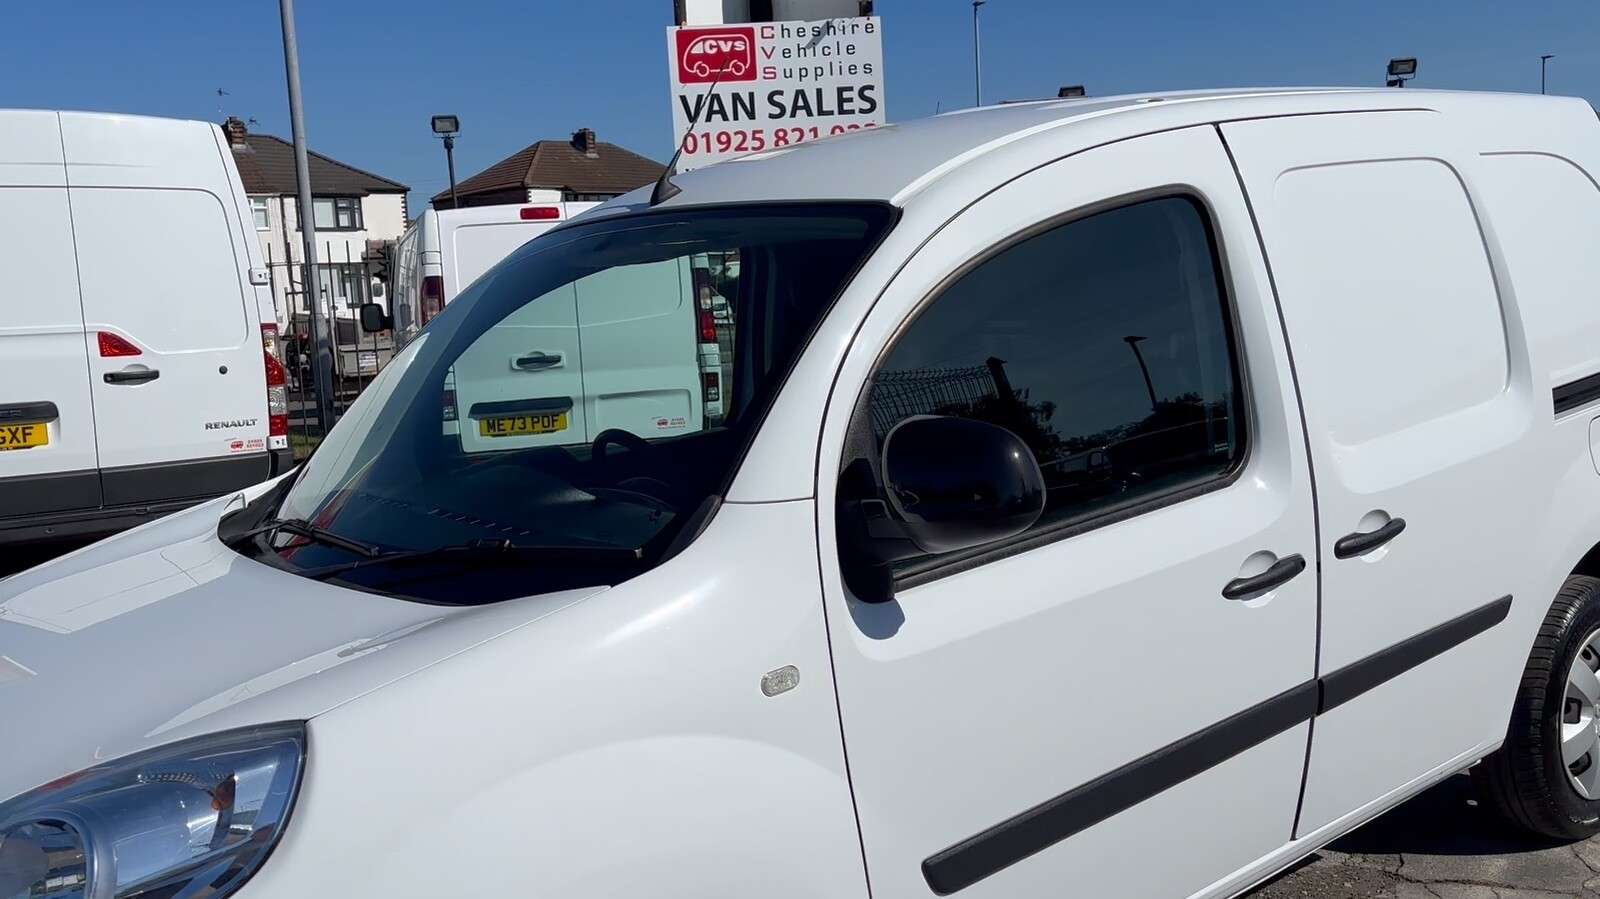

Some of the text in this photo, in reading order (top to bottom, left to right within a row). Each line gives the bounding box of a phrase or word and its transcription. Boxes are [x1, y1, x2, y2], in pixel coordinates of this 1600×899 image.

[760, 20, 875, 39] Cheshire
[703, 39, 746, 54] CVS
[760, 41, 856, 60] Vehicle
[762, 61, 873, 82] Supplies
[679, 84, 877, 123] VAN SALES
[683, 129, 765, 154] 01925
[205, 418, 258, 430] RENAULT
[486, 416, 528, 433] ME73
